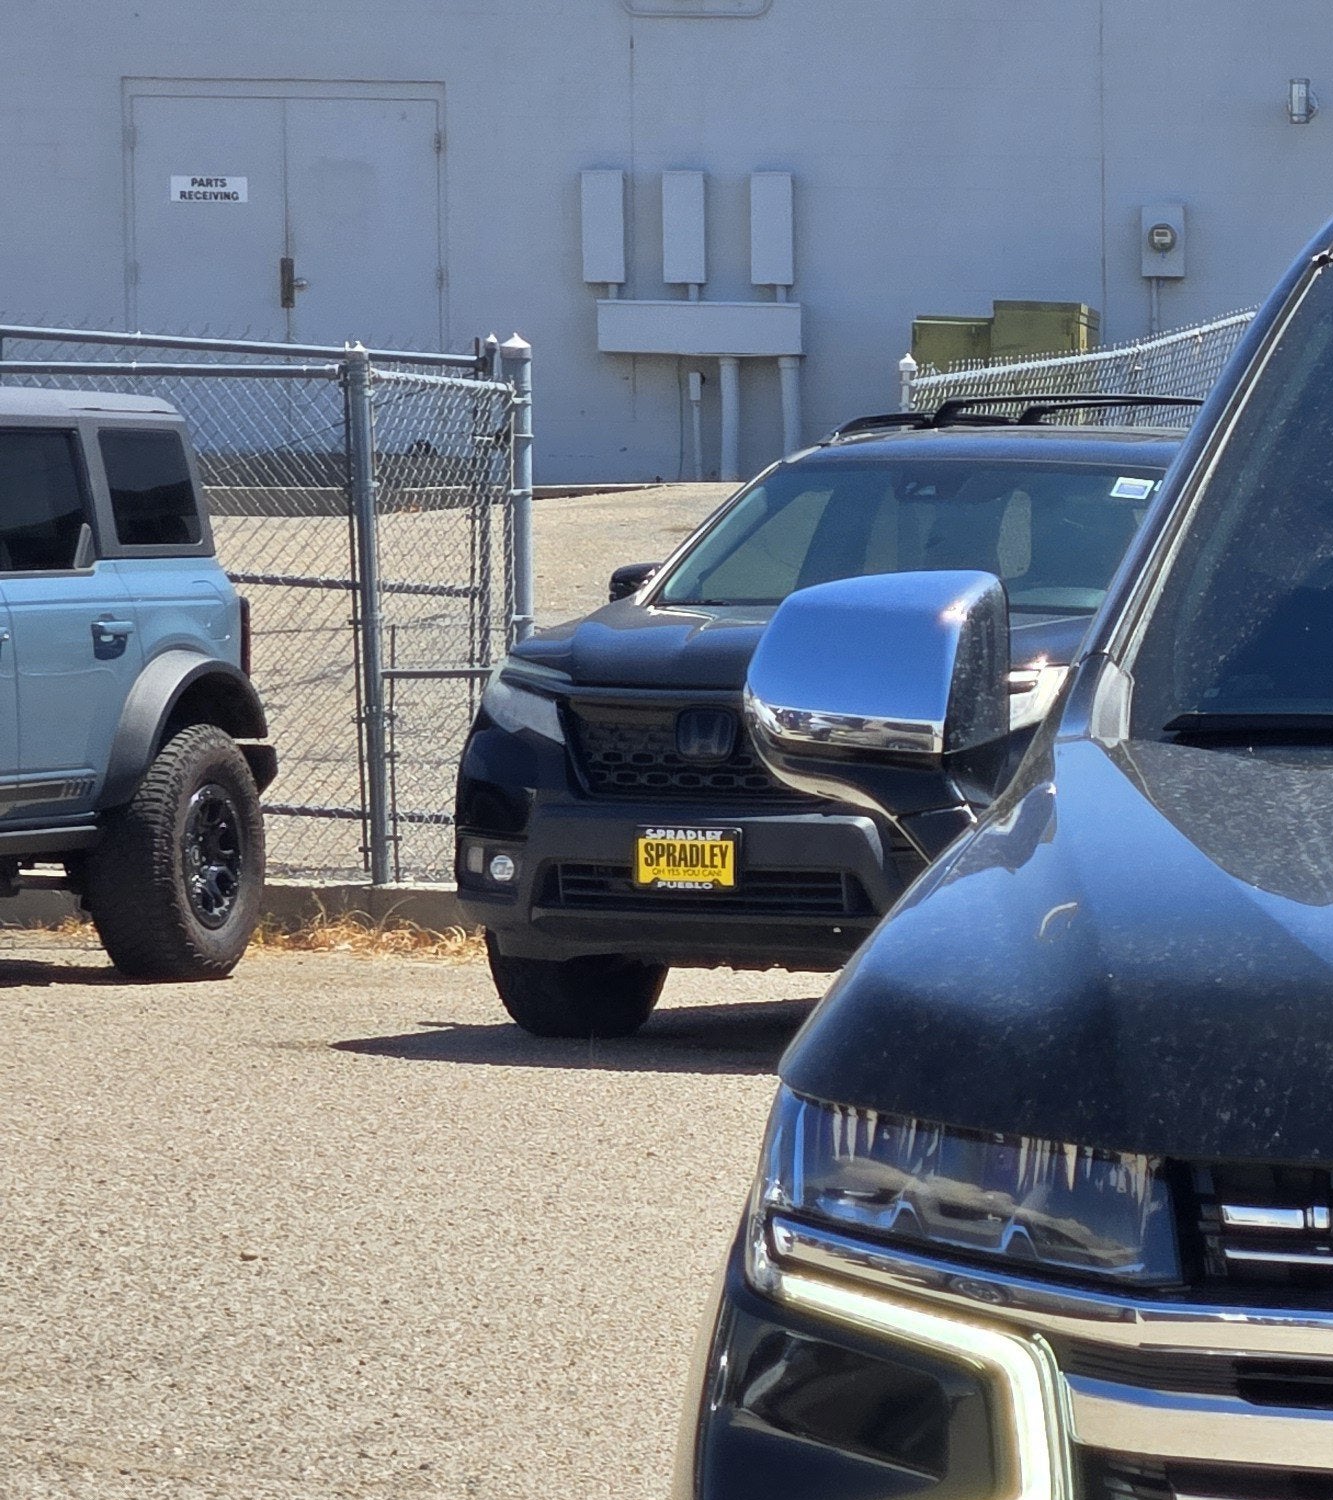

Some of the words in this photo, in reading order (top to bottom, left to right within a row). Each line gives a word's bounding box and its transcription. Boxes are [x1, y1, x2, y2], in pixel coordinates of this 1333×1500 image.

[191, 178, 227, 188] PARTS
[180, 190, 239, 201] RECEIVING
[645, 829, 723, 840] SPRADLEY
[644, 842, 728, 868] SPRADLEY
[652, 868, 665, 876] OH
[668, 868, 680, 876] YES
[682, 868, 700, 877] YOU
[657, 881, 713, 889] PUEBLO
